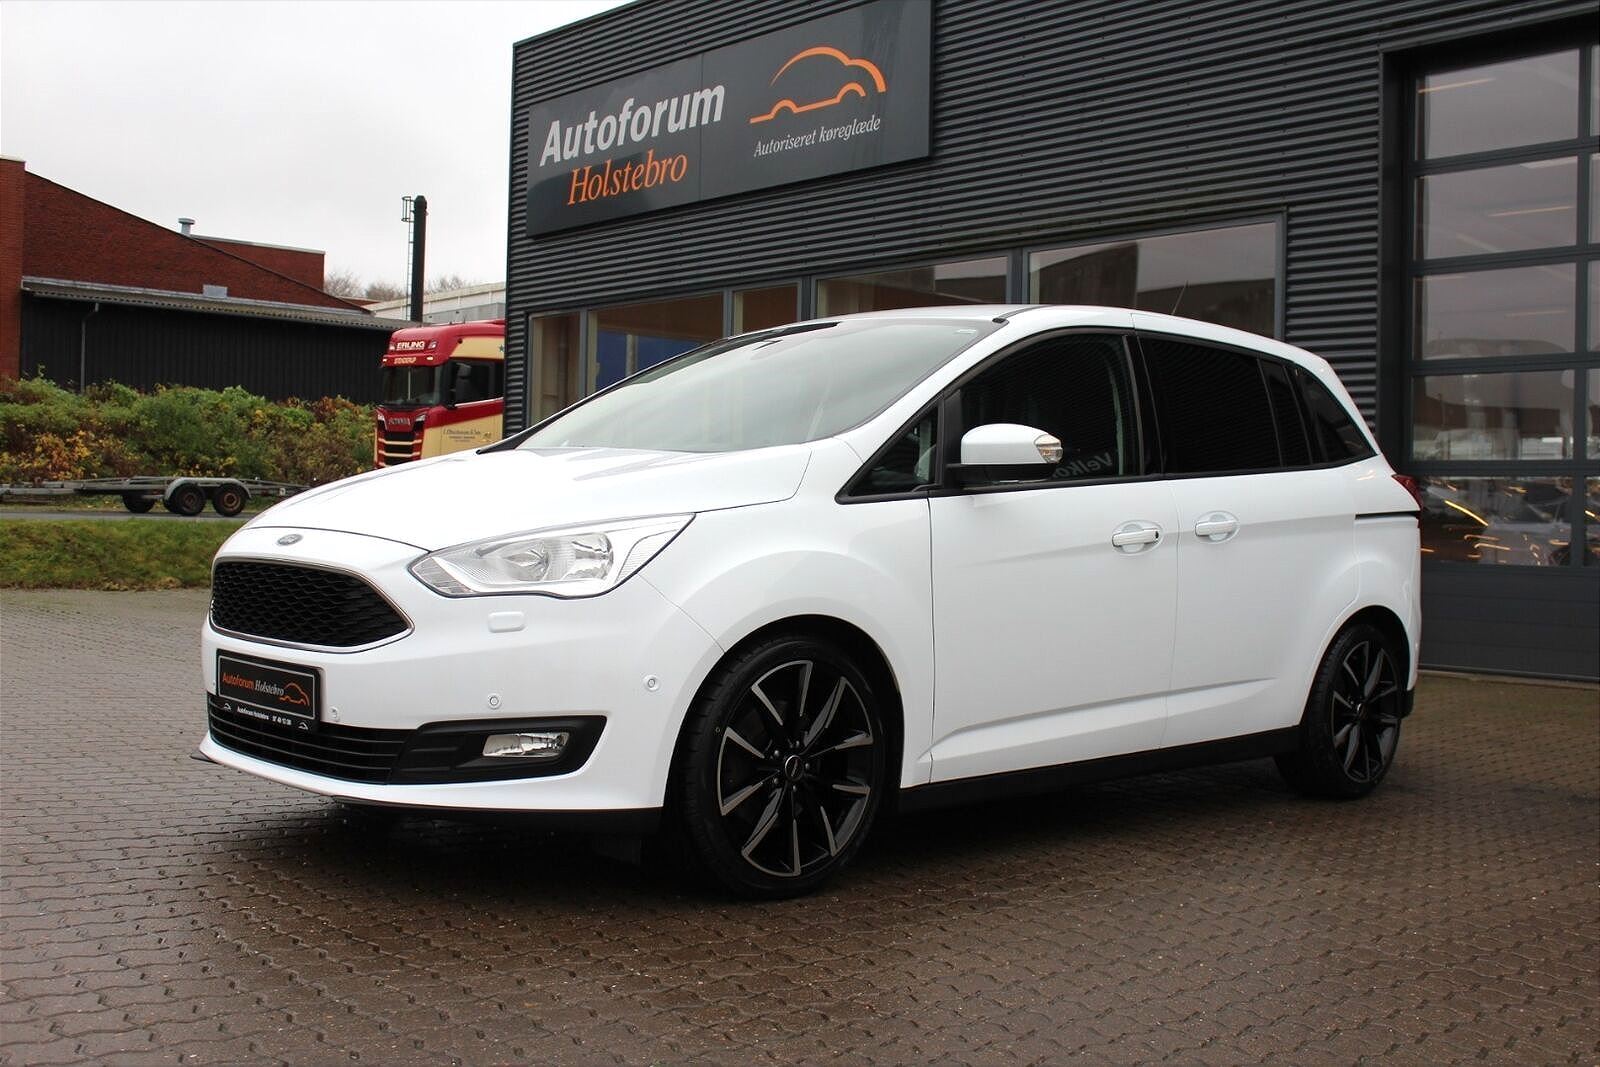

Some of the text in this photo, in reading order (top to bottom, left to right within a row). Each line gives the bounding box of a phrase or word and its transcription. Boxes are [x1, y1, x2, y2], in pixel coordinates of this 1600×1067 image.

[539, 84, 725, 167] Autoforum
[753, 114, 881, 157] Autoriseret køreglæde
[567, 149, 688, 205] Holstebro
[396, 341, 425, 350] ERLING
[223, 673, 285, 696] Autoforum Holstebro
